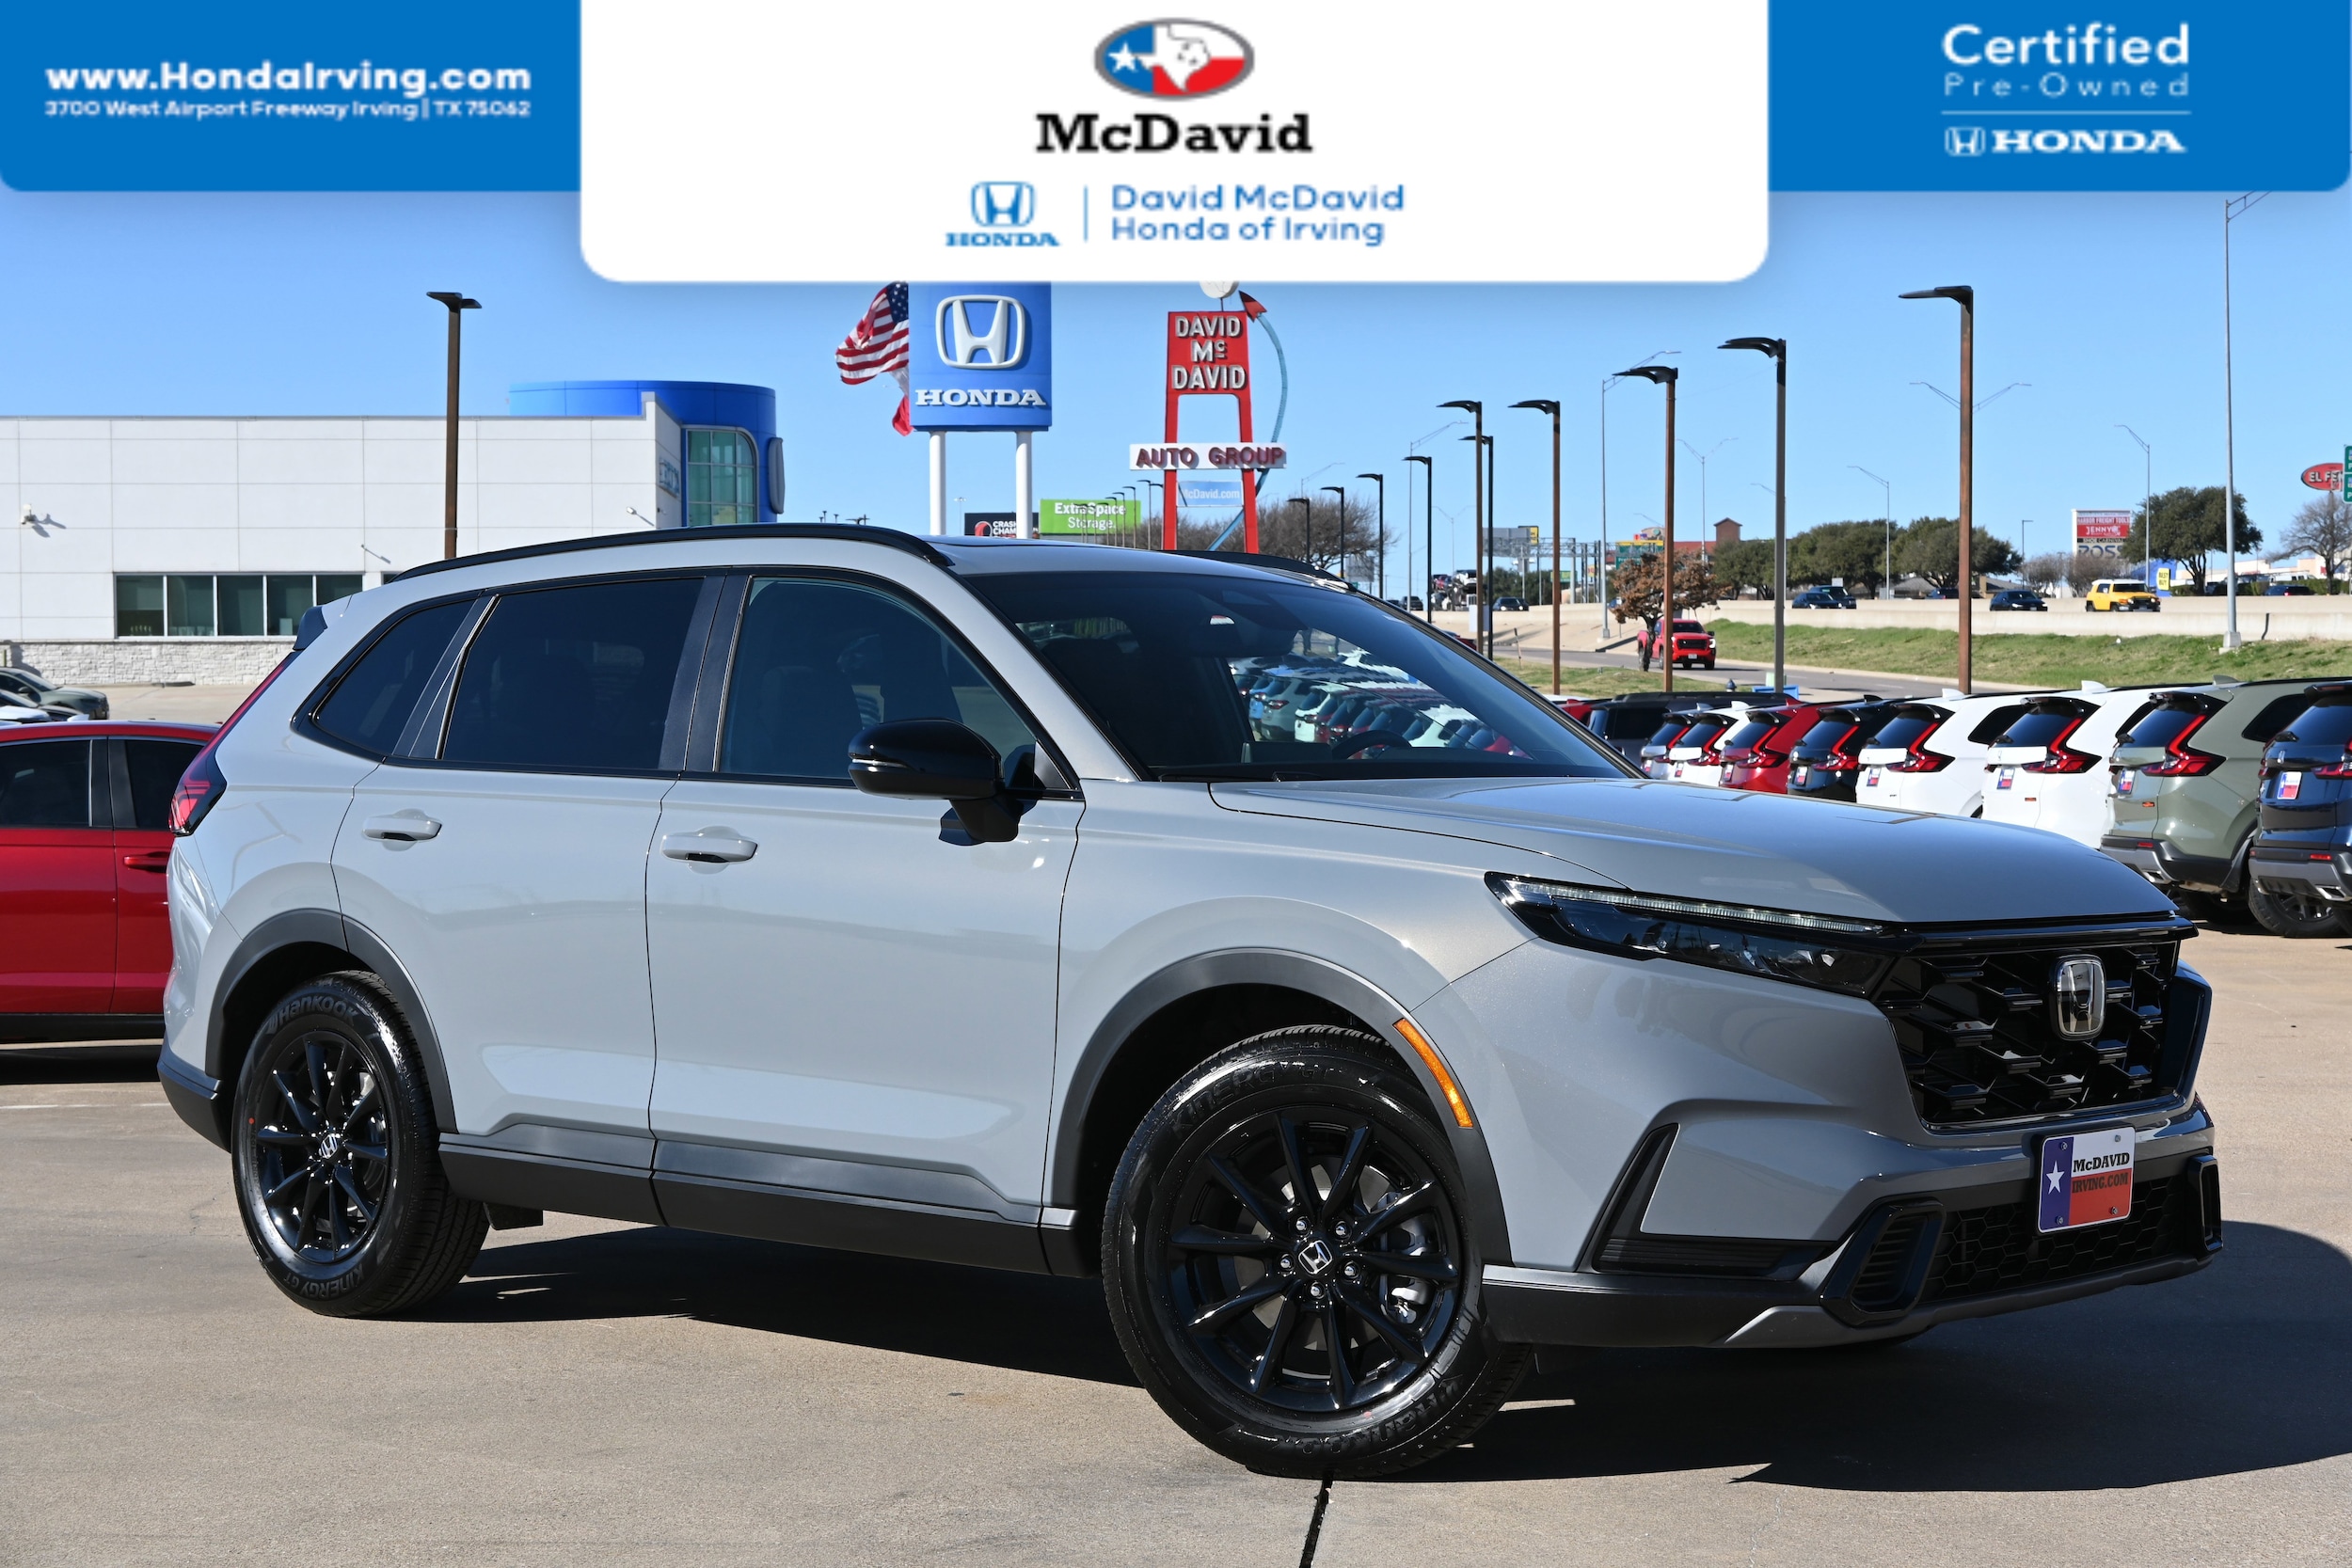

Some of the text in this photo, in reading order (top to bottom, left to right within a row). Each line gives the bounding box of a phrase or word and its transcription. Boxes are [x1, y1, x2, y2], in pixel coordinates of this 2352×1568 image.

[1175, 316, 1241, 338] DAVID
[1171, 365, 1246, 389] DAVID
[914, 388, 1046, 406] HONDA
[1136, 447, 1283, 467] AUTO GROUP
[2310, 472, 2343, 483] EL FEN
[2073, 1152, 2130, 1173] McDAVID
[2072, 1172, 2129, 1194] IRVING.COM
